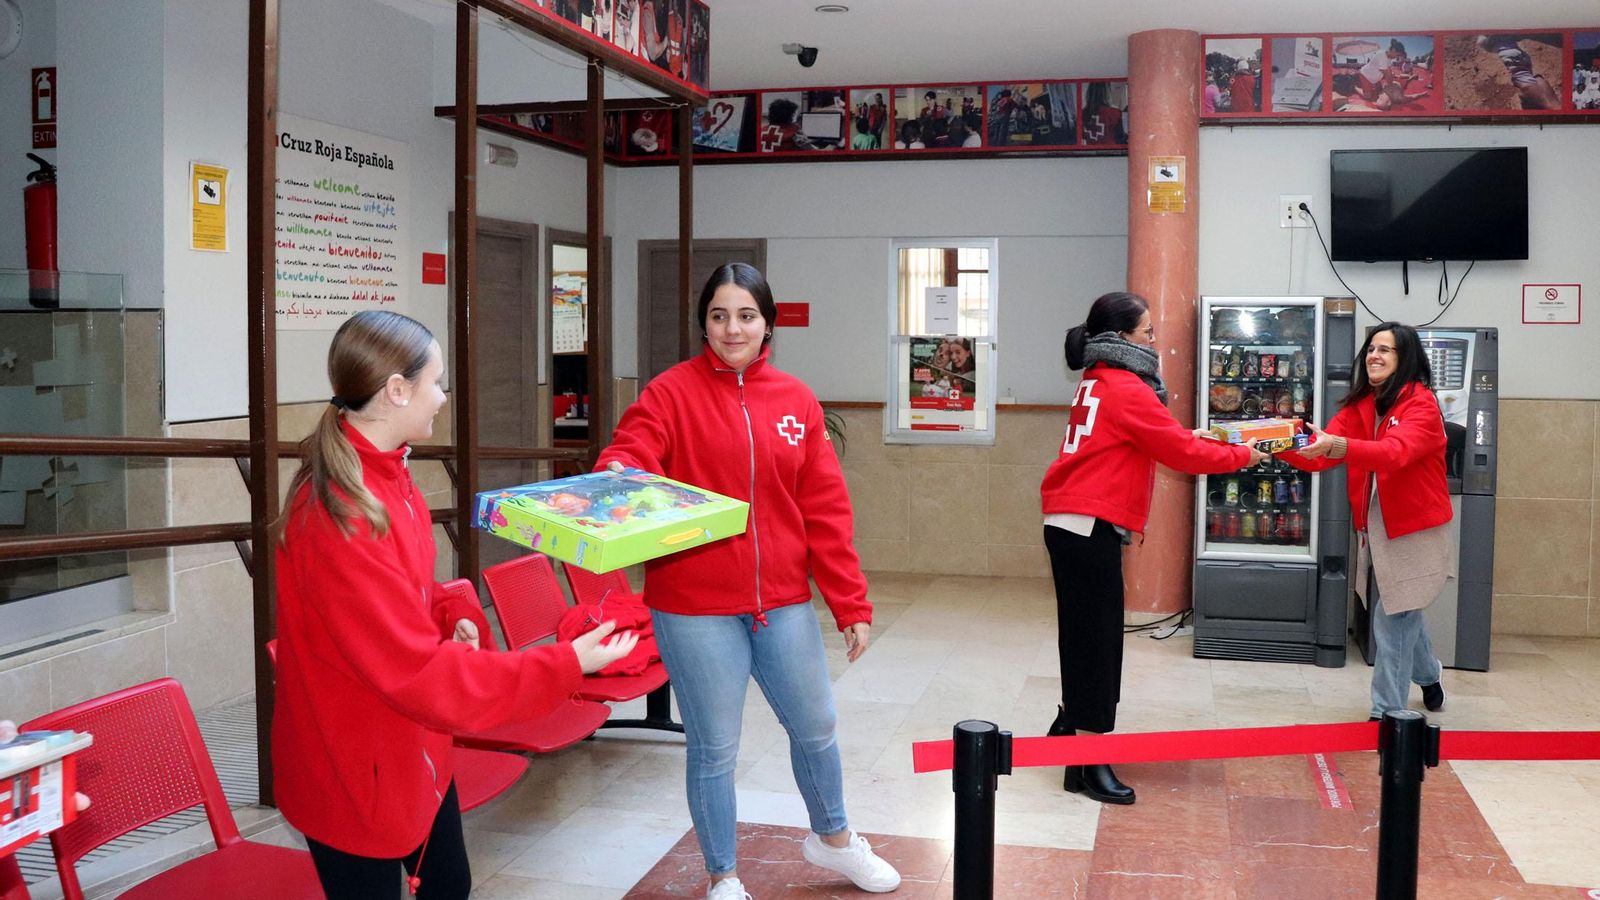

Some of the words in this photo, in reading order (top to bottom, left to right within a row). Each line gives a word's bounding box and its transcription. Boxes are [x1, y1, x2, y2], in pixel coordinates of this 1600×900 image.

[281, 132, 312, 153] Cruz
[315, 139, 342, 162] Roja
[345, 146, 394, 170] Española
[313, 176, 360, 196] welcome
[363, 200, 395, 218] vitejte
[287, 223, 332, 237] willkommen
[328, 242, 382, 260] bienvenidos
[276, 268, 325, 283] benvenuto
[352, 290, 369, 301] dalal
[370, 290, 379, 301] ak
